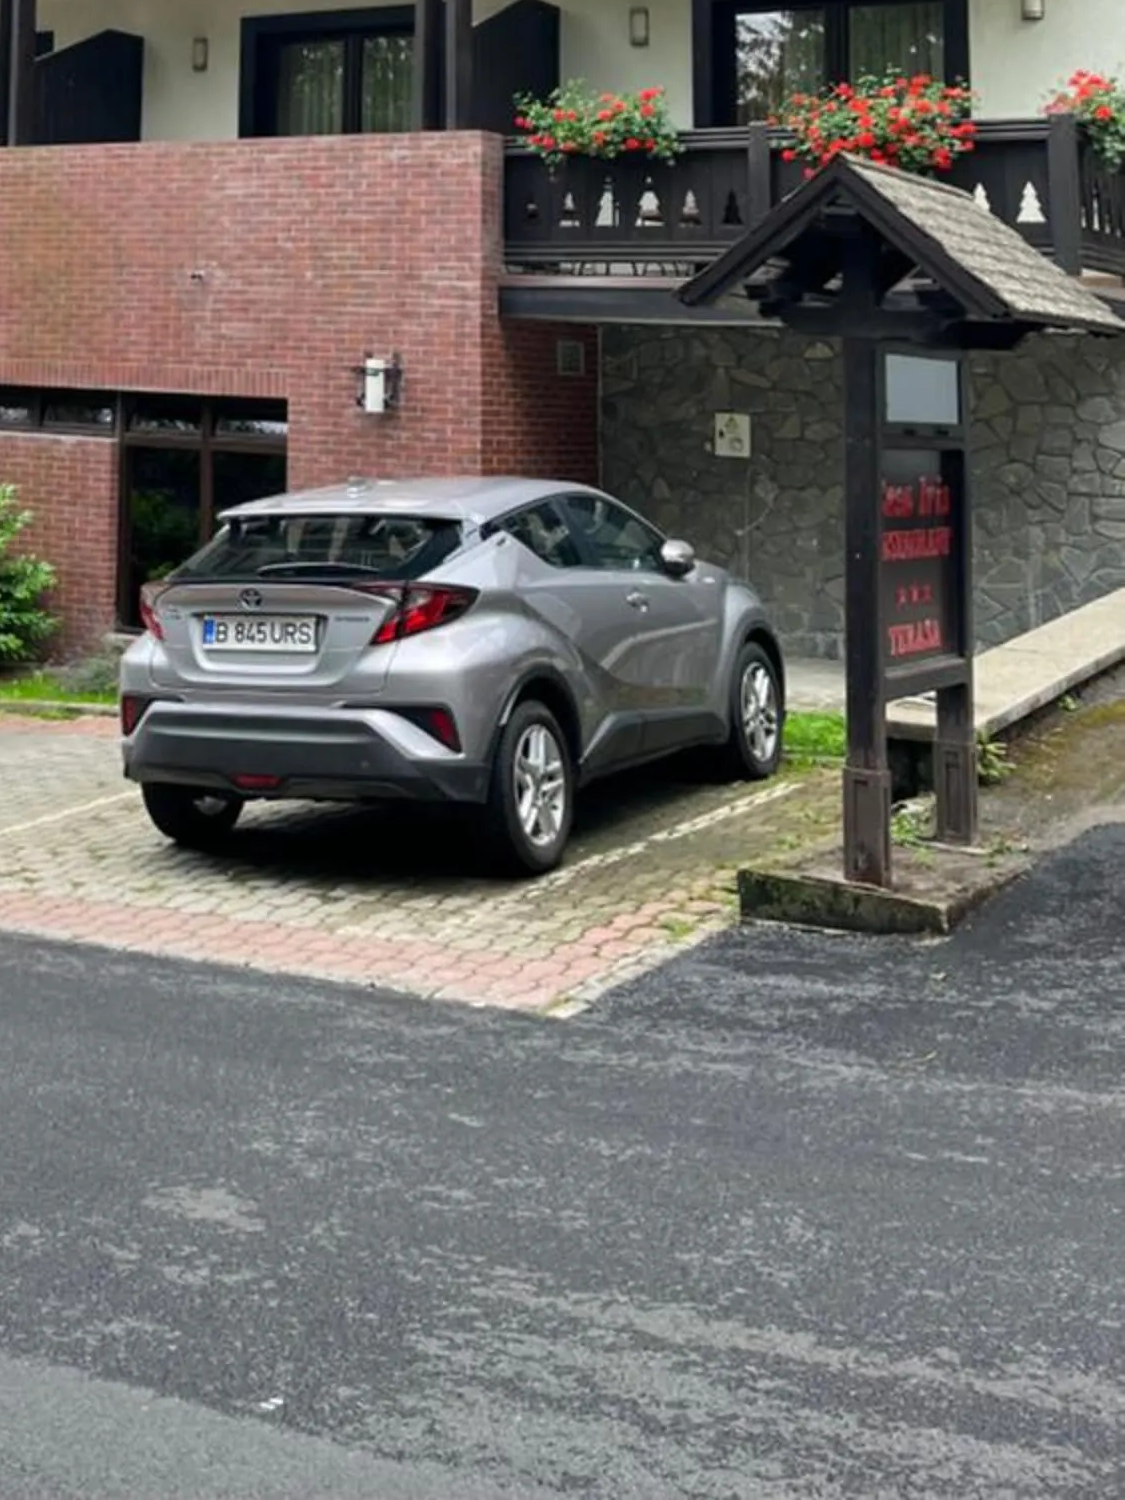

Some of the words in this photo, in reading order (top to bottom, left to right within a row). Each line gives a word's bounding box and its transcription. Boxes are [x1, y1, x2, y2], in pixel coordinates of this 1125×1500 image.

[215, 621, 228, 643] B
[235, 621, 268, 643] 845
[271, 621, 312, 645] URS
